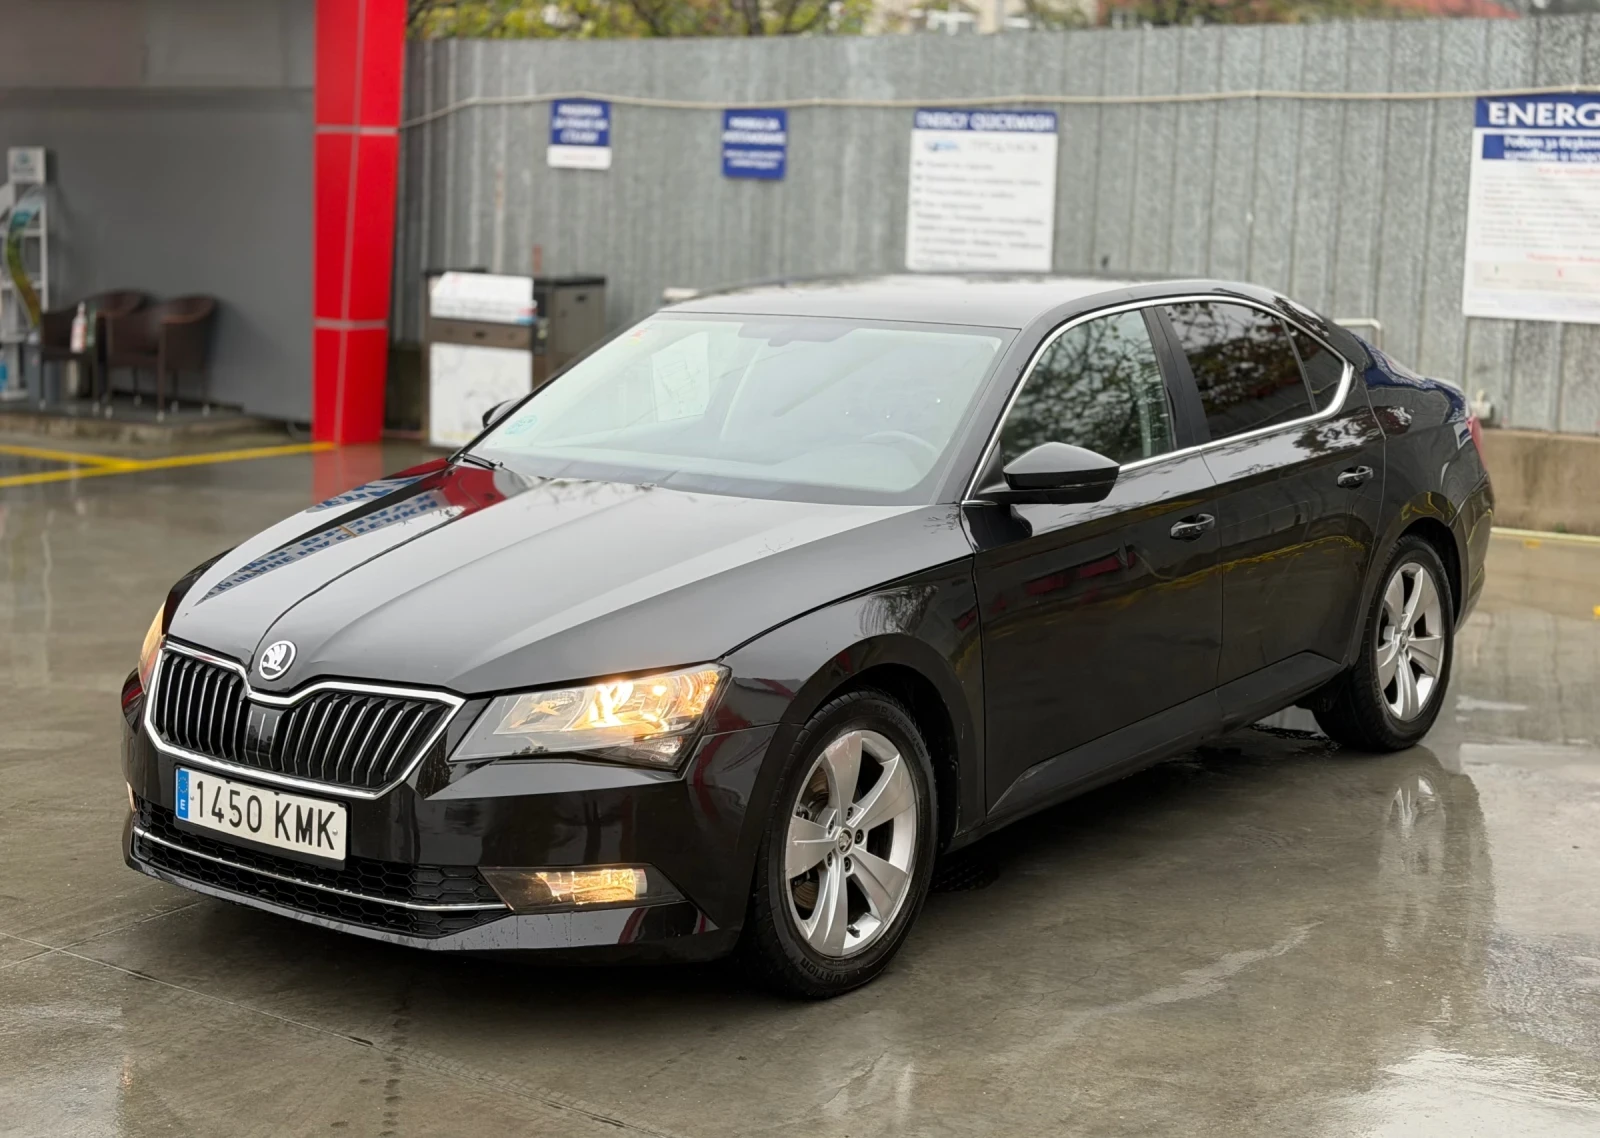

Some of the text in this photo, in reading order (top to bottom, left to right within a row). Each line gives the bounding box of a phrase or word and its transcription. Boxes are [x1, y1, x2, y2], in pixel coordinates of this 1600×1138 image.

[1489, 102, 1600, 127] ENERG
[180, 798, 186, 811] E
[197, 781, 336, 850] 1450 KMK
